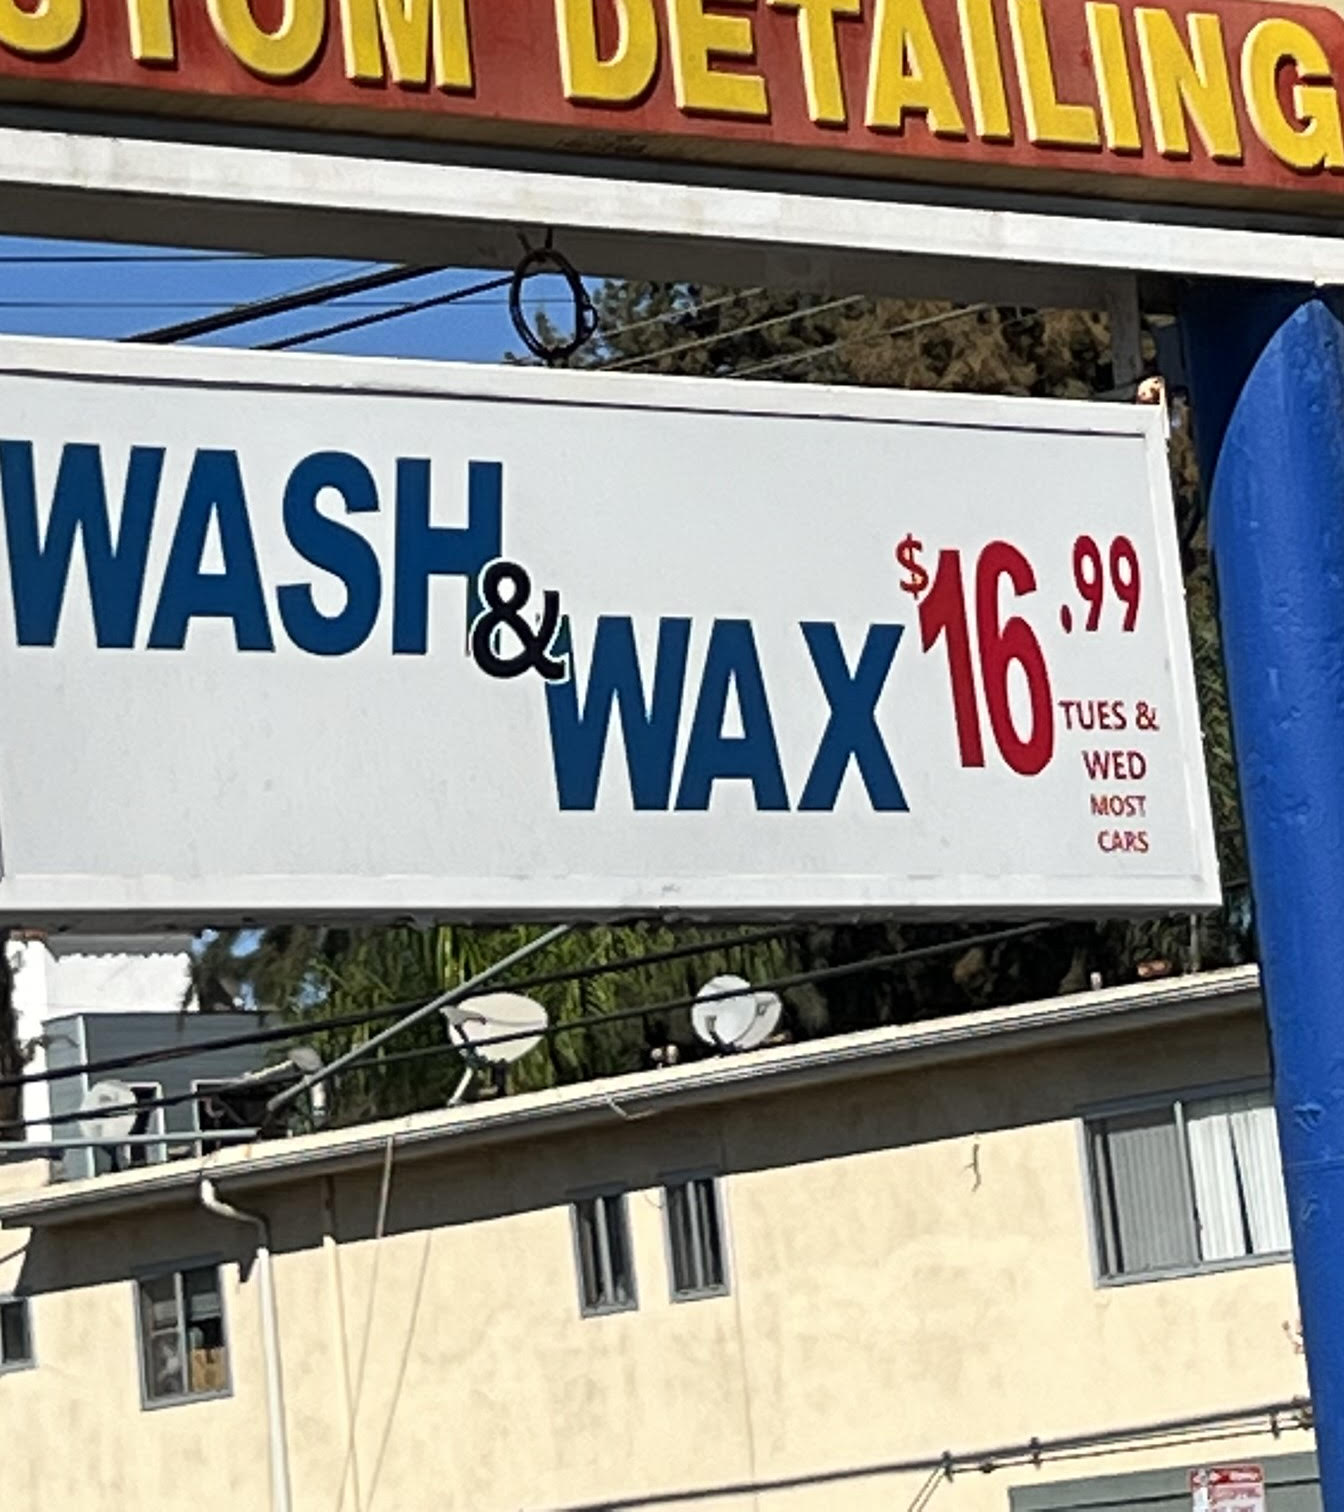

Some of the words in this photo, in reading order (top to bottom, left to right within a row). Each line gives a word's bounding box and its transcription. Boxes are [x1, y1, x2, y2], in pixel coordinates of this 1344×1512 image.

[472, 561, 566, 679] &
[544, 614, 911, 813] WAX
[1058, 700, 1127, 731] TUES
[1136, 701, 1160, 731] &
[1082, 750, 1146, 780] WED
[1090, 794, 1147, 817] MOST
[1097, 830, 1149, 853] CARS
